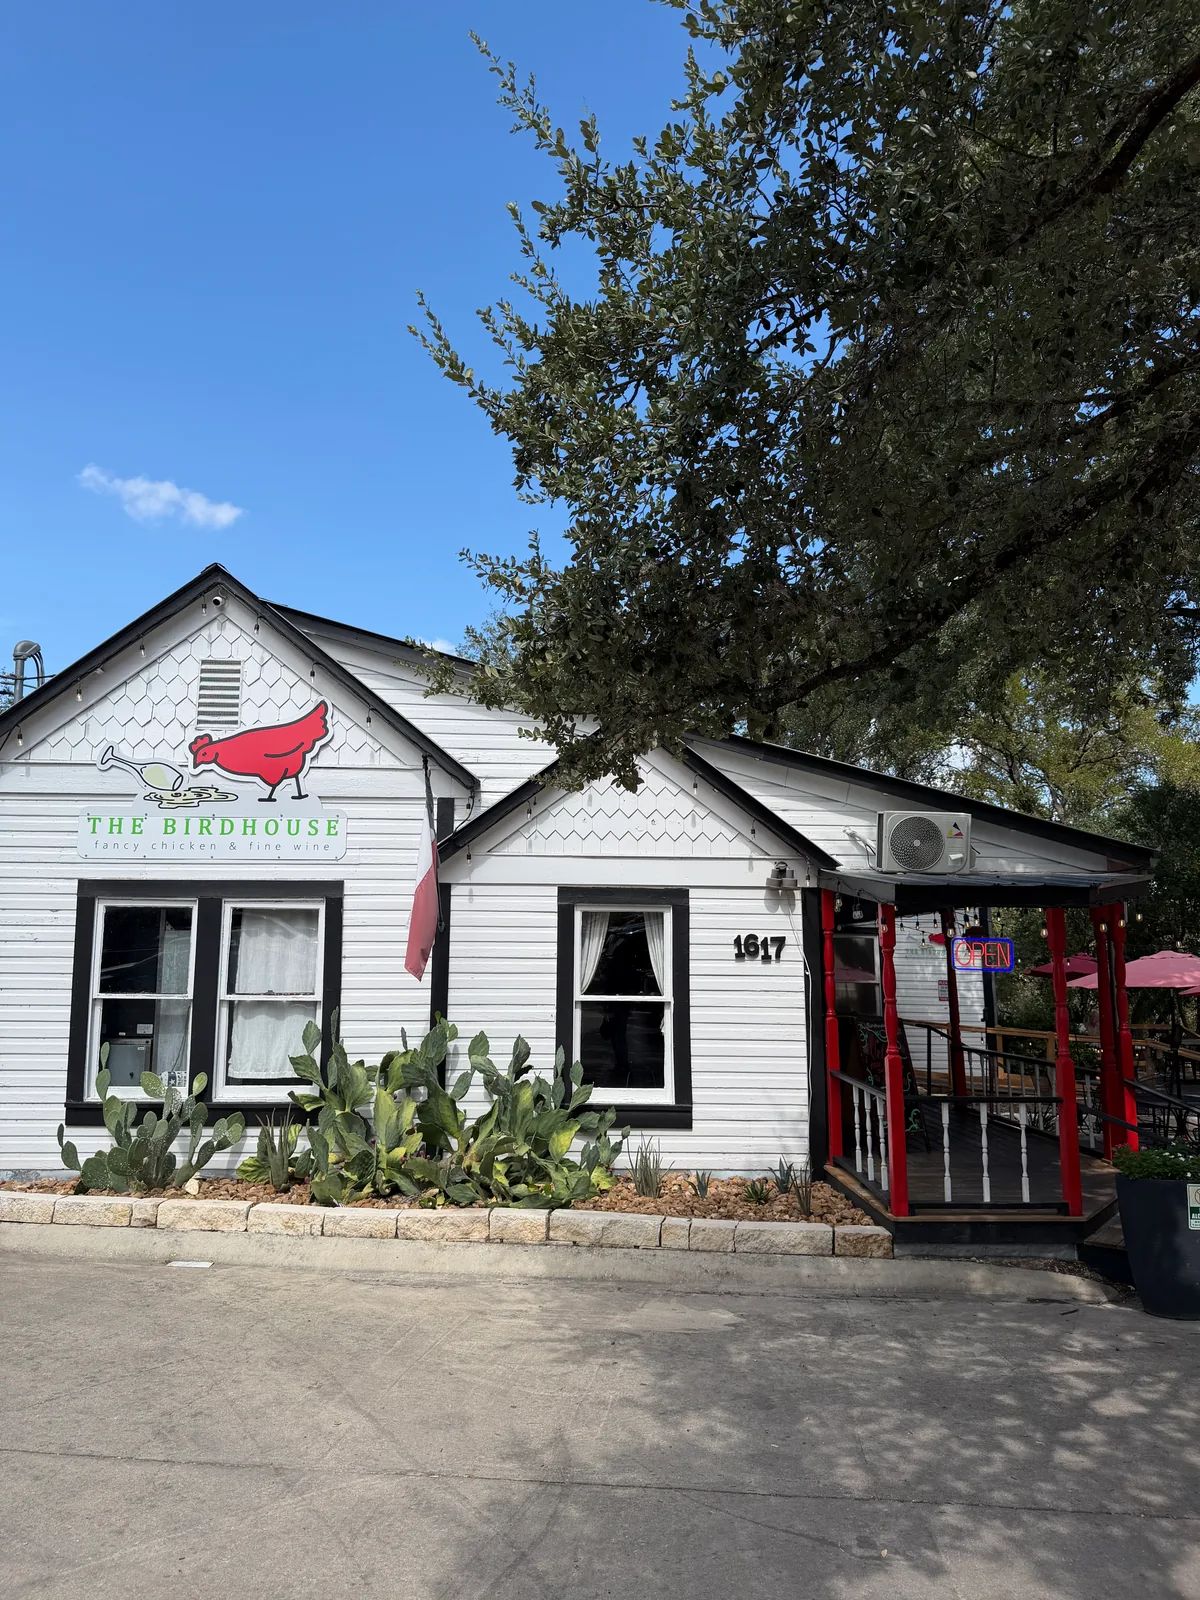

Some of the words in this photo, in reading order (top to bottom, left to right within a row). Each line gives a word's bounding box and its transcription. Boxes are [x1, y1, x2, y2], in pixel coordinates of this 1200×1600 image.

[88, 817, 144, 834] THE
[163, 817, 339, 836] BIRDHOUSE
[94, 840, 140, 852] fancy
[151, 841, 217, 851] chicken
[228, 841, 237, 850] &
[249, 841, 281, 851] fine
[293, 841, 330, 851] wine
[733, 933, 786, 963] 1617
[955, 942, 1010, 967] OPEN
